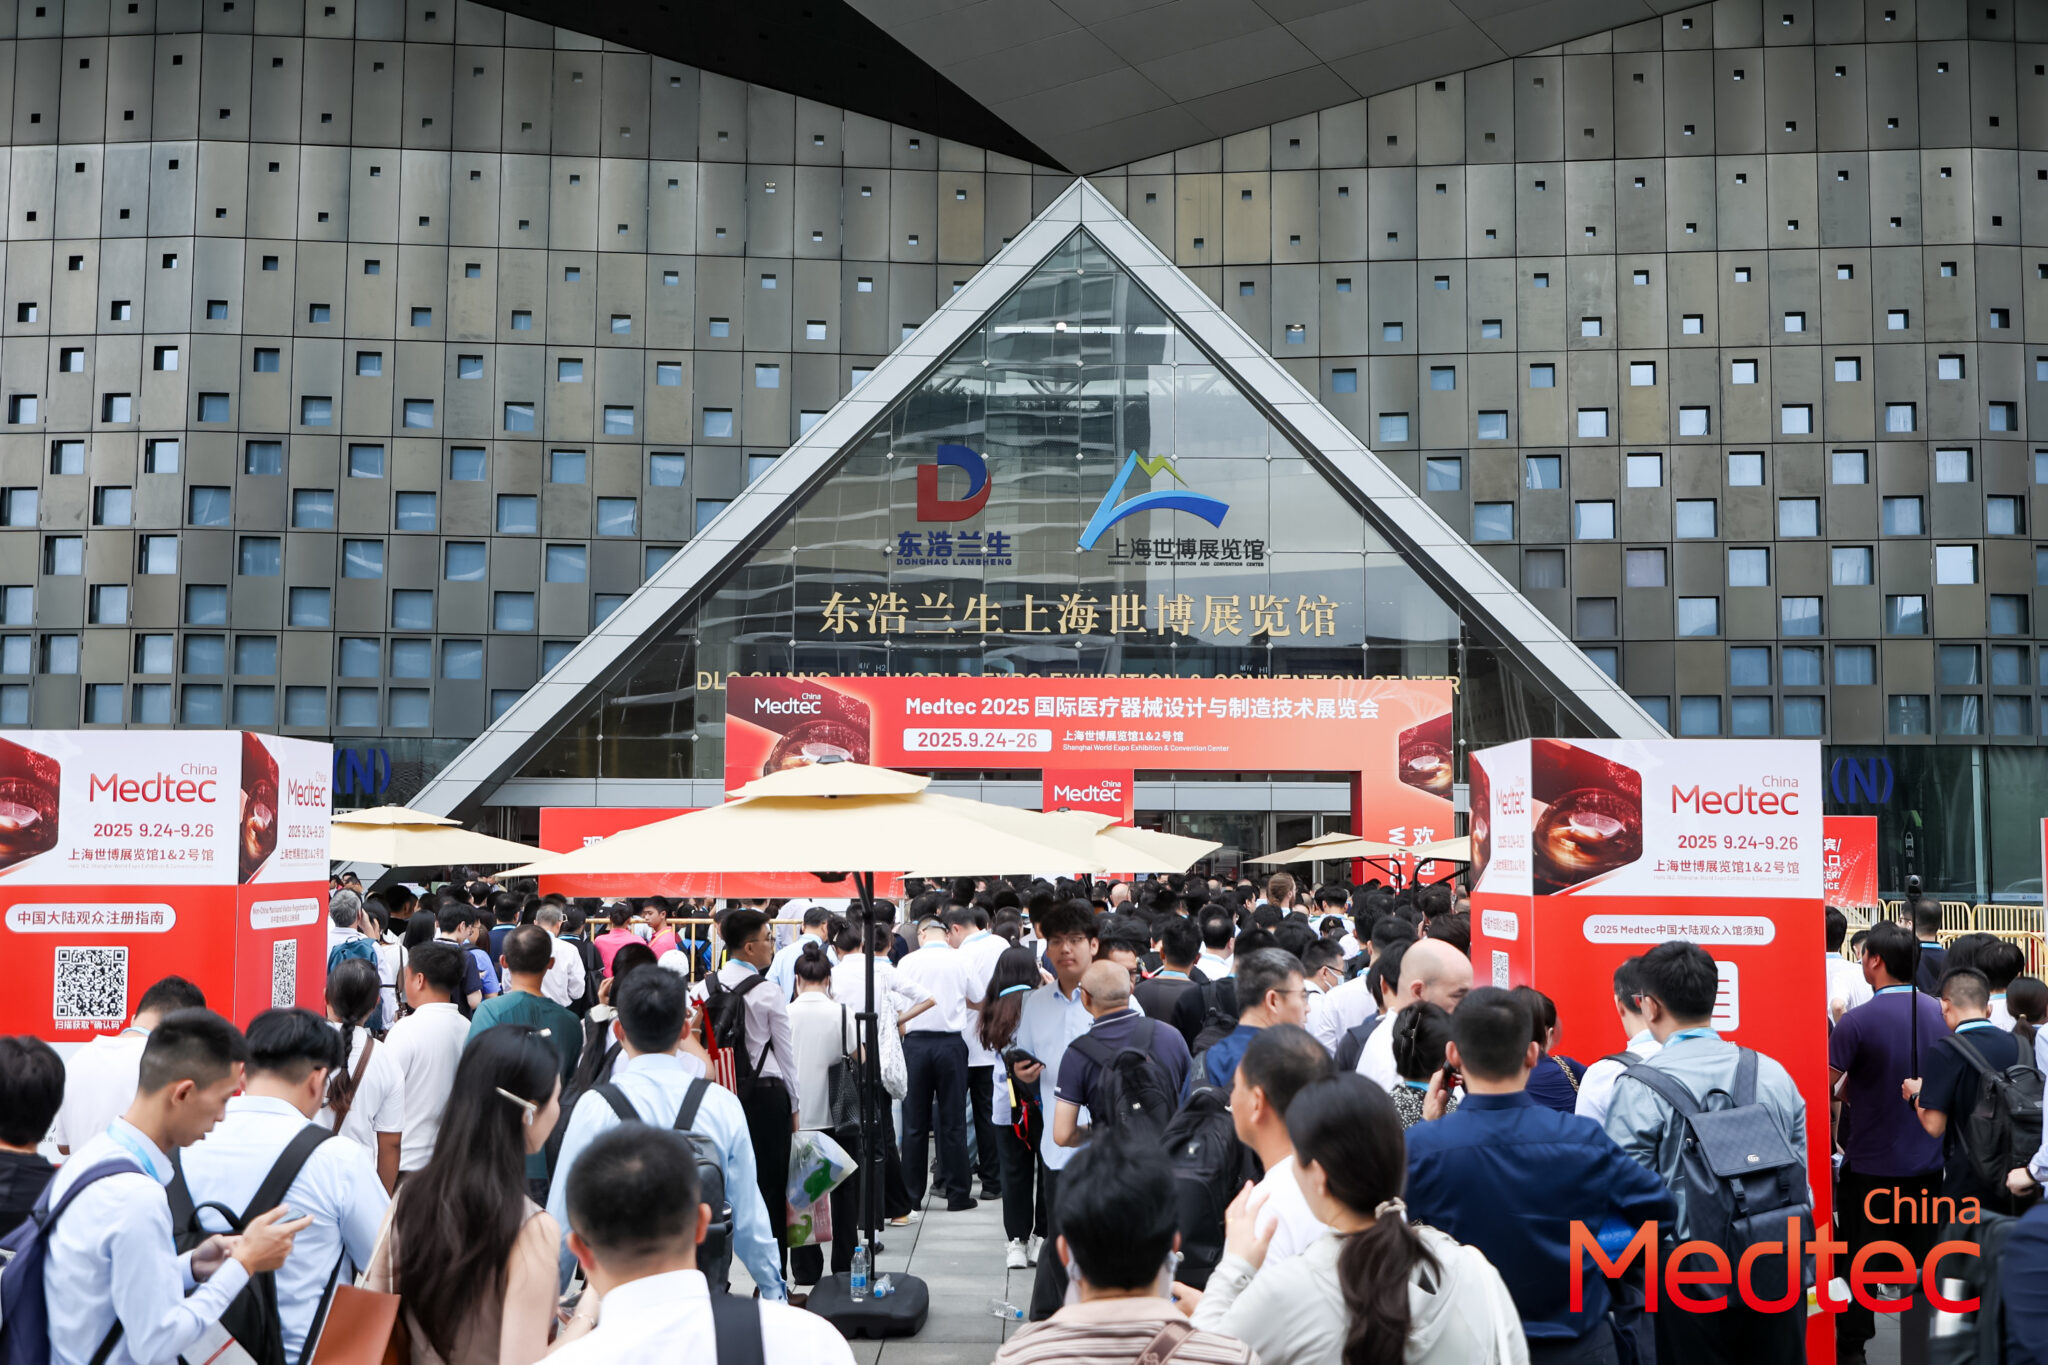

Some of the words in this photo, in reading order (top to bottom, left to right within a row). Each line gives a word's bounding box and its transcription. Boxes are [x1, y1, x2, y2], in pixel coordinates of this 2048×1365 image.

[897, 530, 1012, 557] 东浩兰生
[1108, 538, 1265, 560] 上海世博展览馆
[896, 558, 949, 566] DONGHAO
[952, 558, 1012, 566] LANSHENG
[819, 591, 1340, 637] 东浩兰生上海世博展览馆
[801, 692, 822, 701] China
[754, 697, 822, 715] Medtec
[905, 697, 976, 715] Medtec
[981, 698, 1030, 715] 2025
[1034, 696, 1380, 719] 国际医疗器械设计与制造技术展览会
[918, 732, 1038, 749] 2025.9.24-26
[1063, 730, 1184, 742] 上海世博展览馆1&2号馆
[1063, 744, 1093, 752] Shanghai
[1113, 744, 1130, 752] Expo
[1131, 744, 1163, 752] Exhibition
[1170, 744, 1207, 752] Convention
[1207, 744, 1229, 752] Center
[181, 763, 218, 776] China
[89, 772, 217, 803] Medtec
[1101, 780, 1122, 788] China
[1762, 775, 1799, 788] China
[287, 778, 327, 808] Medtec
[1054, 785, 1122, 802] Medtec
[1671, 784, 1799, 816] Medtec
[93, 824, 133, 838] 2025
[139, 824, 214, 838] 9.24-9.26
[1677, 834, 1717, 849] 2025
[1723, 835, 1799, 850] 9.24-9.26
[68, 848, 215, 861] 上海世博展览馆1&2号馆
[1653, 859, 1800, 874] 上海世博展览馆1&2号馆
[17, 910, 165, 926] 中国大陆观众注册指南
[1594, 925, 1618, 935] 2025
[1620, 924, 1765, 937] Medtec中国大陆观众入馆须知
